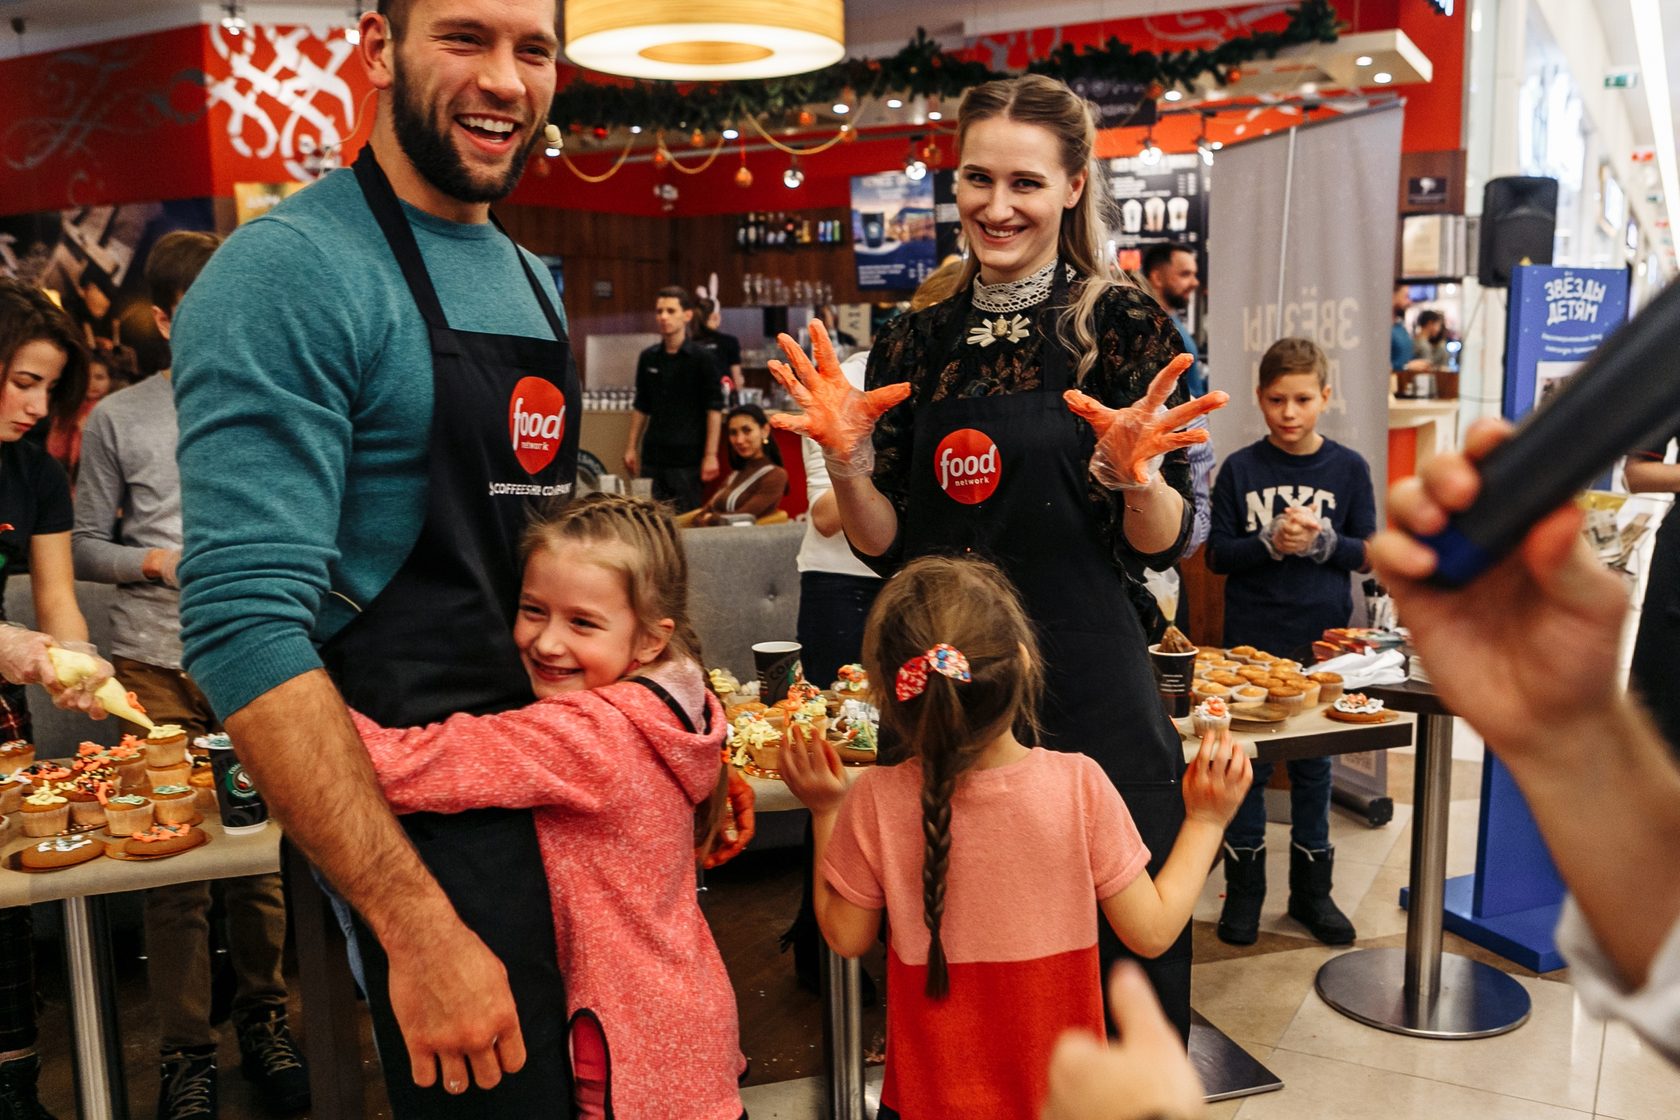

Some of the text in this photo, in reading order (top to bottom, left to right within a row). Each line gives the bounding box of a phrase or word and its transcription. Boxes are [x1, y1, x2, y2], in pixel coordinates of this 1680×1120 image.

[1544, 271, 1606, 302] ЗВЁЗДЫ
[1546, 299, 1598, 326] ДЕТЯМ
[513, 397, 566, 451] food
[940, 443, 997, 490] food
[955, 476, 990, 486] network
